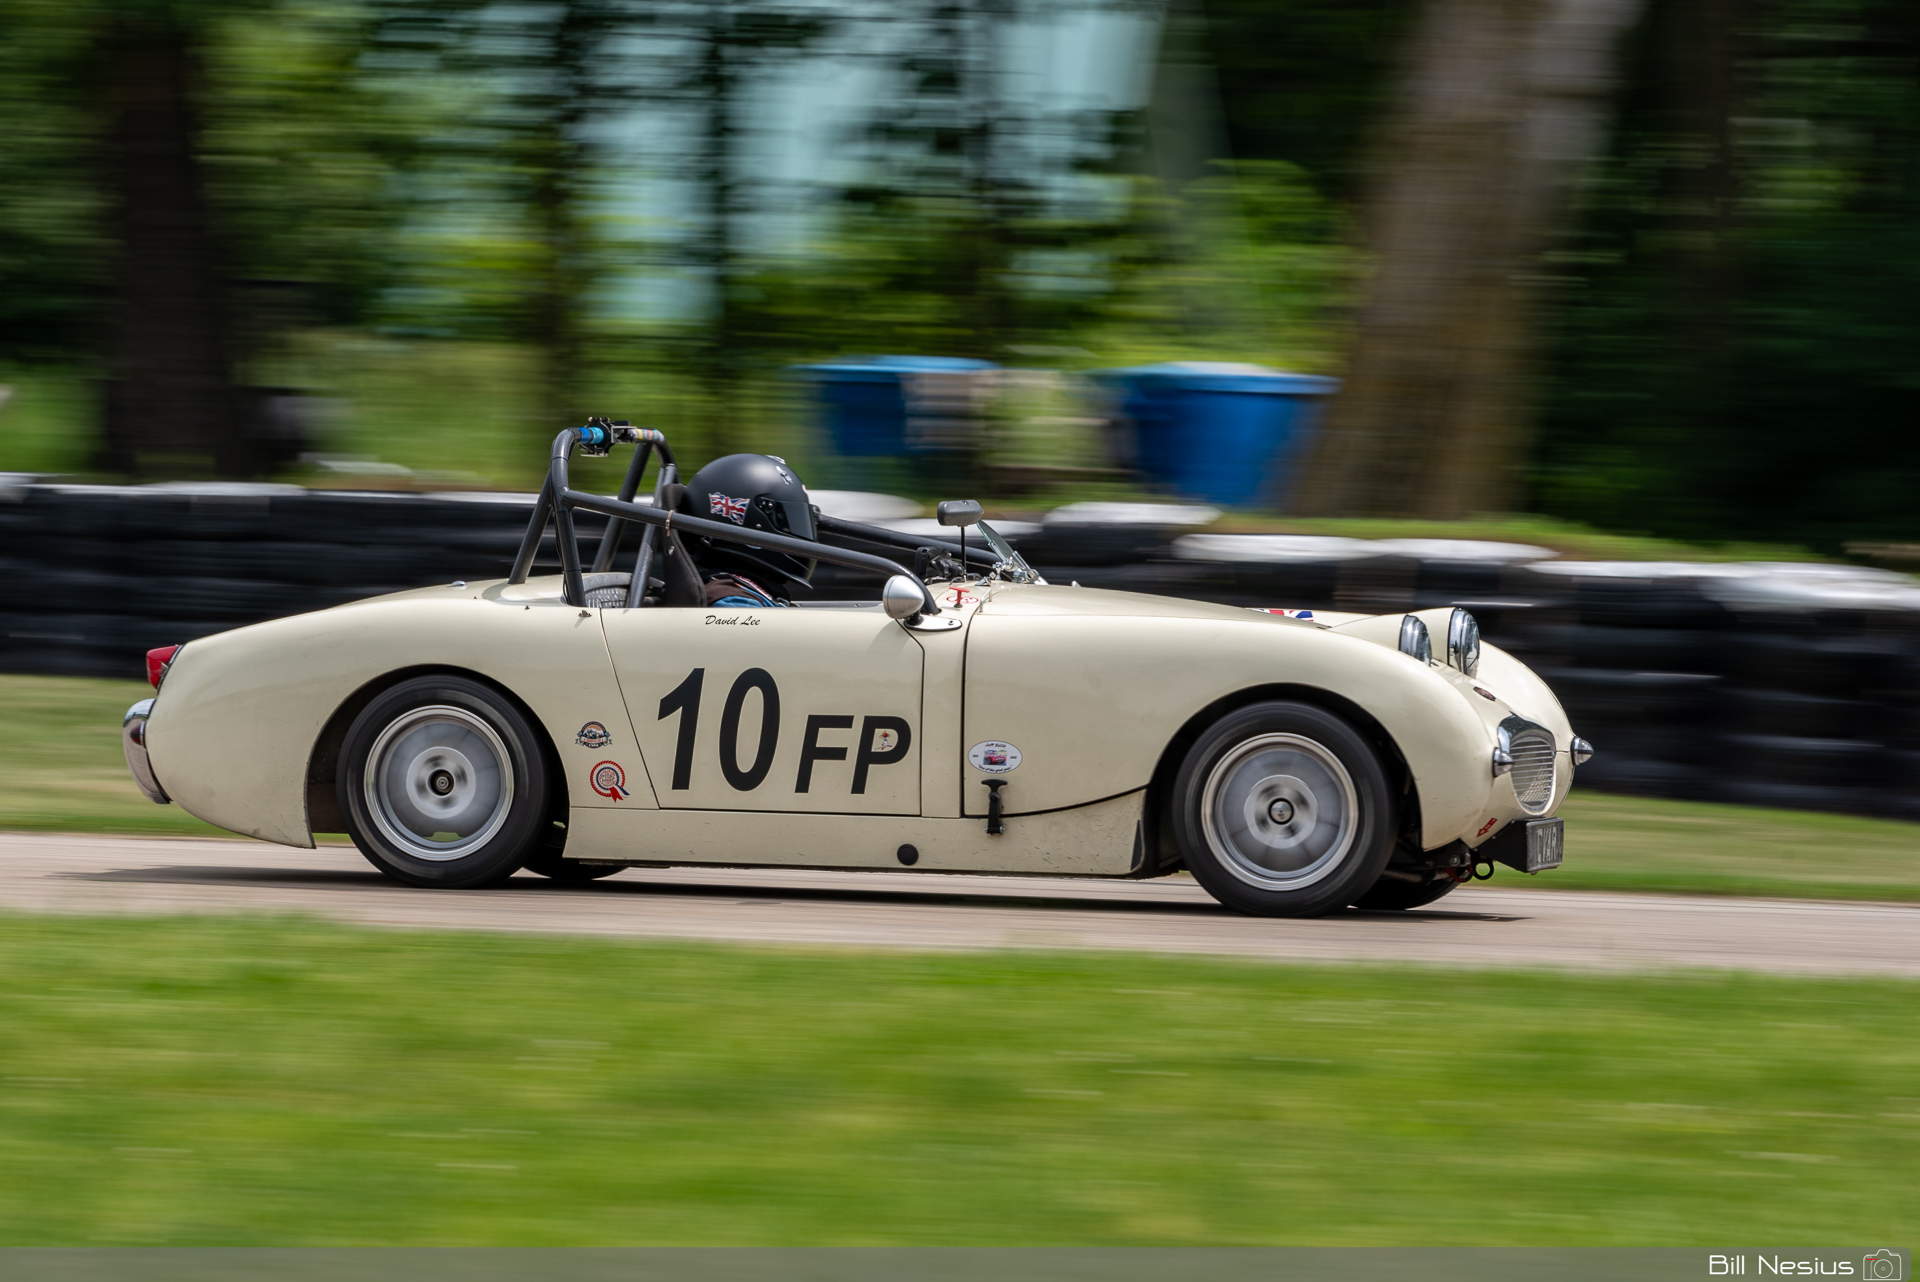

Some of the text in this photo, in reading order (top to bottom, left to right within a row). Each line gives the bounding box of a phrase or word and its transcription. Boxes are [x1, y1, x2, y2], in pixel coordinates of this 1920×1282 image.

[705, 615, 761, 626] David Lee
[657, 667, 912, 795] 10 FP
